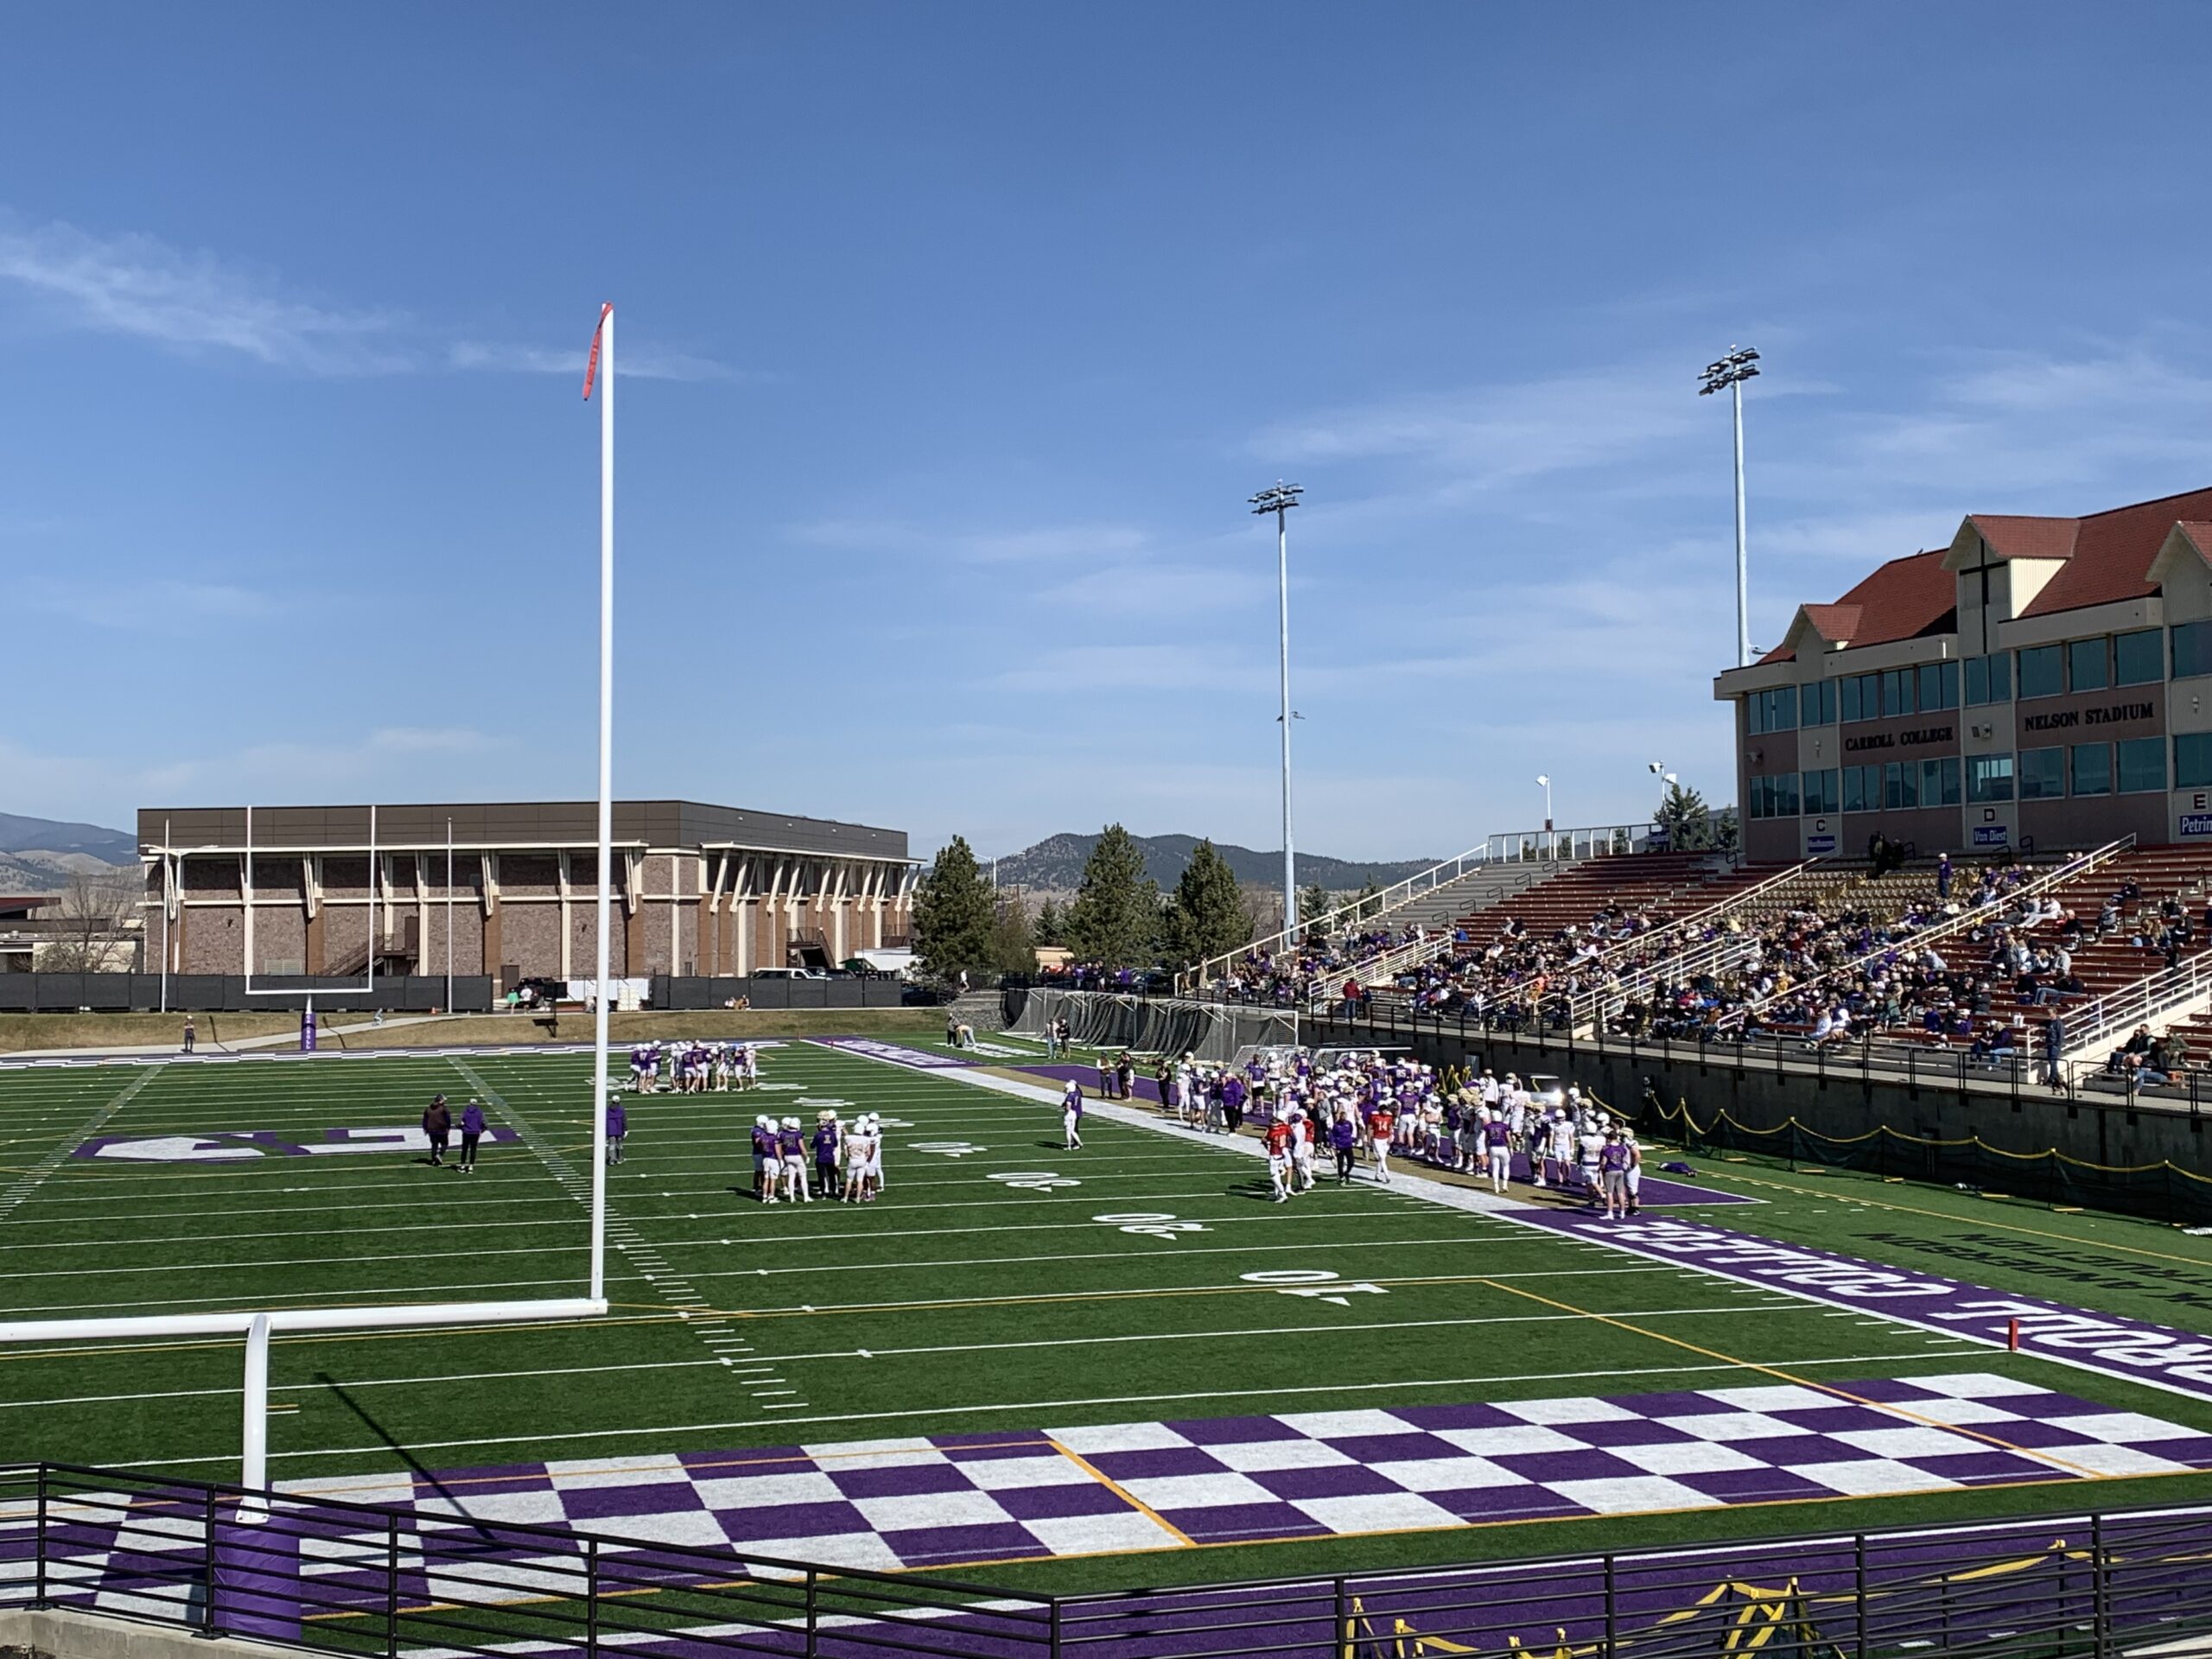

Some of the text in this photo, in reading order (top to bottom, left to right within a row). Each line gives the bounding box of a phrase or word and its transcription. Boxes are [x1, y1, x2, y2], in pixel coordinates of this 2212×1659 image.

[2024, 702, 2154, 731] NELSON STADIUM
[1845, 727, 1953, 752] CARROLL COLLEGE
[2193, 793, 2207, 810] E
[1816, 818, 1826, 832] C
[1983, 808, 1996, 823] D
[1974, 830, 1988, 842] Van
[1091, 1212, 1214, 1234] 20
[1570, 1221, 1957, 1298] COLLEGE
[1239, 1270, 1390, 1297] 10
